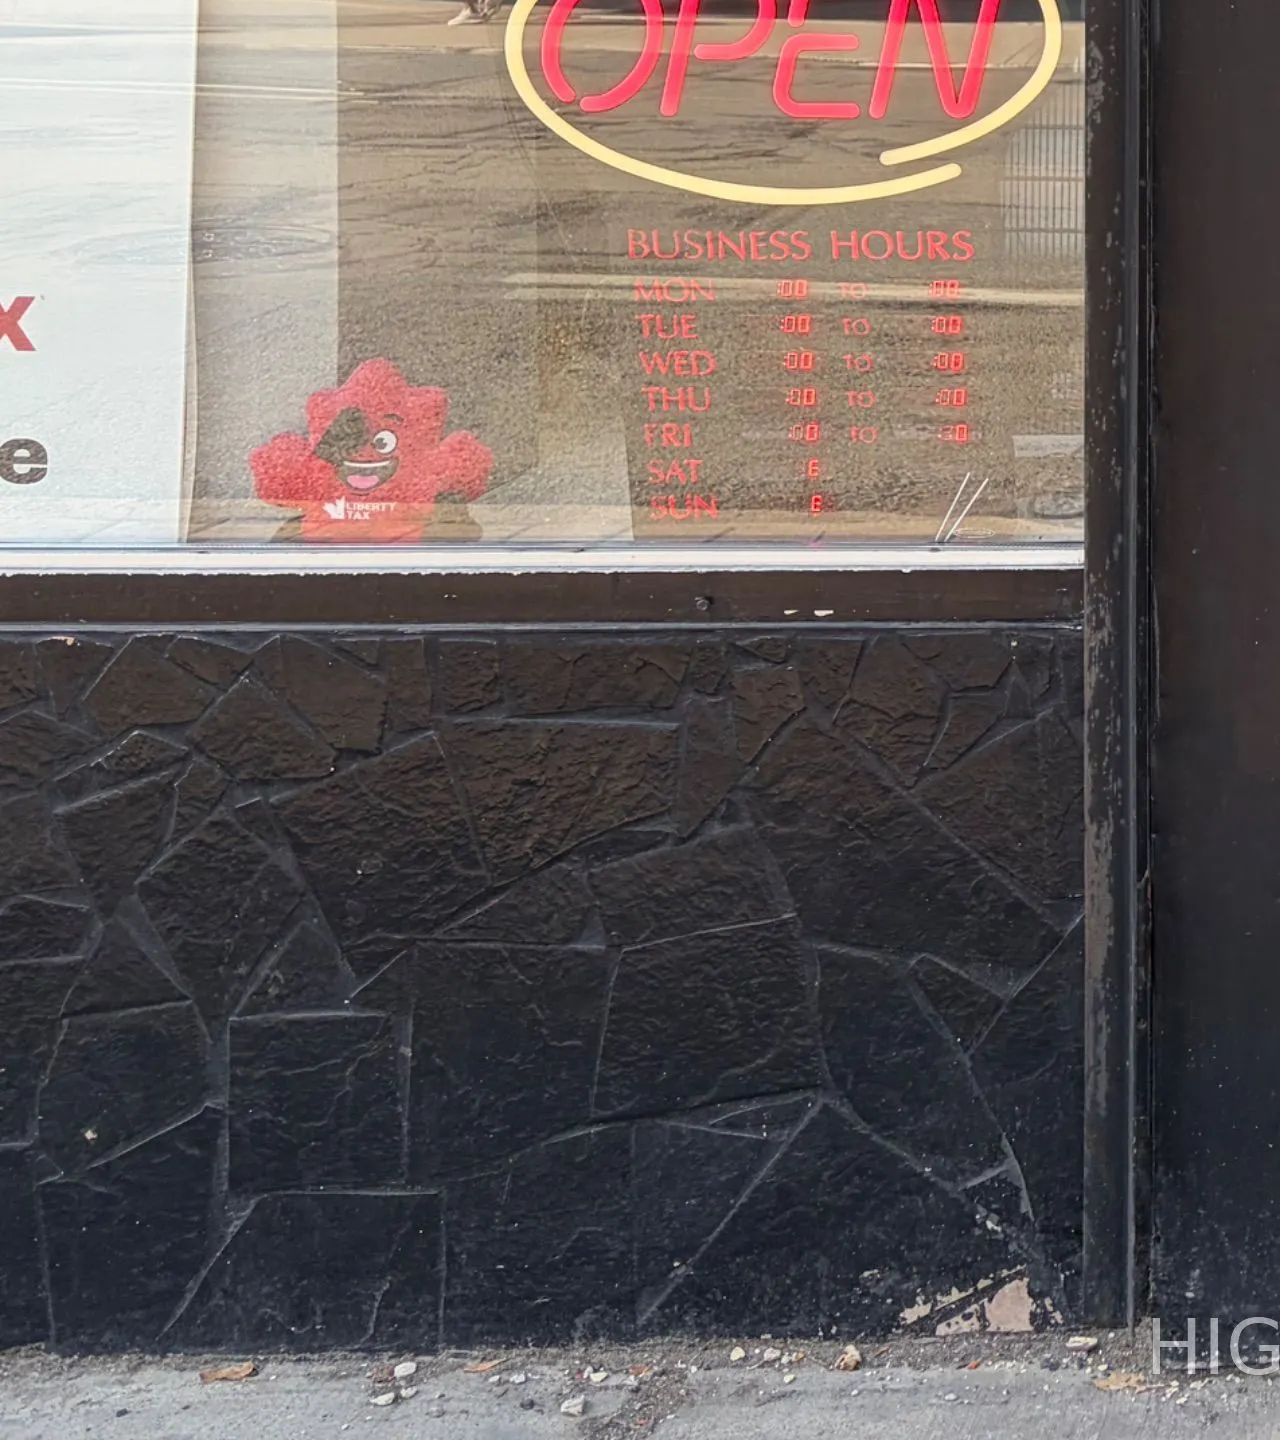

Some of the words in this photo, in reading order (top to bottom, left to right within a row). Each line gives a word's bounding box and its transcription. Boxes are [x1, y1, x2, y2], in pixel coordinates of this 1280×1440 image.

[627, 228, 812, 261] BUSINESS
[830, 230, 975, 262] HOURS
[633, 276, 716, 302] MON
[636, 314, 698, 340] TUE
[639, 350, 717, 376] WED
[641, 386, 712, 412] THU
[644, 423, 692, 448] FRI
[648, 459, 702, 485] SAT
[346, 511, 370, 520] TAX
[650, 495, 718, 520] SUN
